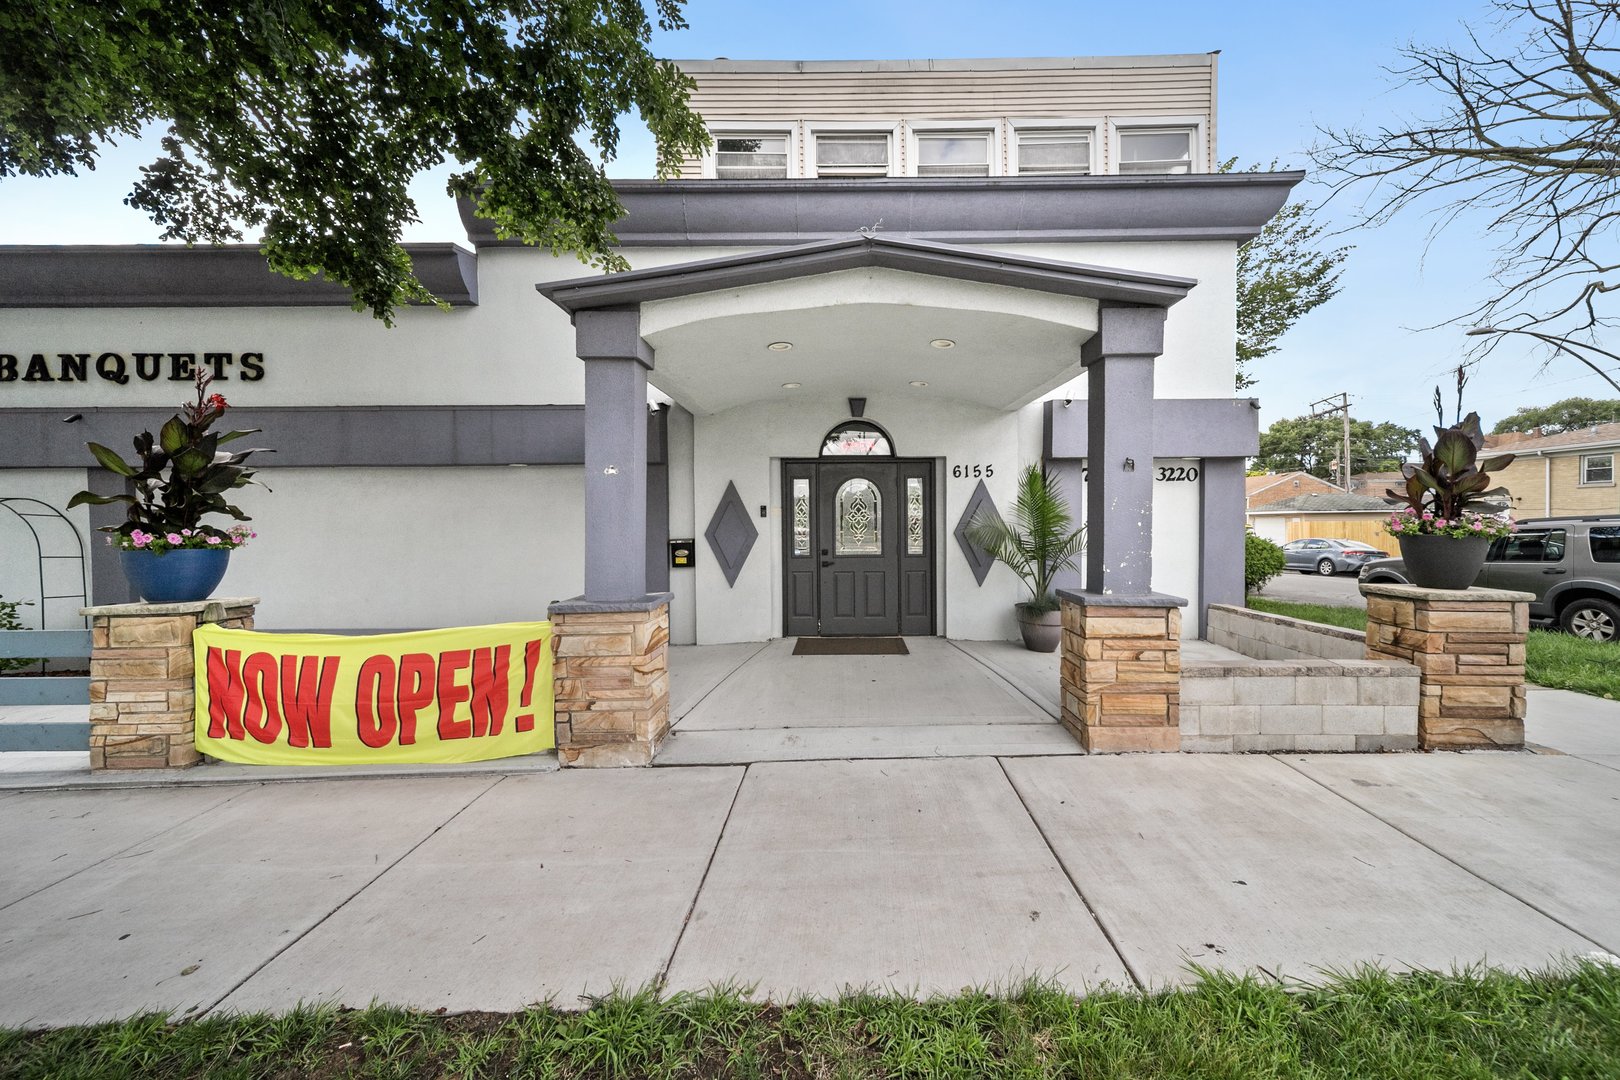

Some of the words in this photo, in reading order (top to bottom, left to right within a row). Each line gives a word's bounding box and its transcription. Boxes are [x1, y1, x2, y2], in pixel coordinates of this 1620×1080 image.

[0, 352, 265, 385] BANQUETS
[952, 464, 994, 478] 6155
[1155, 467, 1199, 482] 3220
[206, 646, 341, 748] NOW
[355, 639, 542, 748] OPEN!
